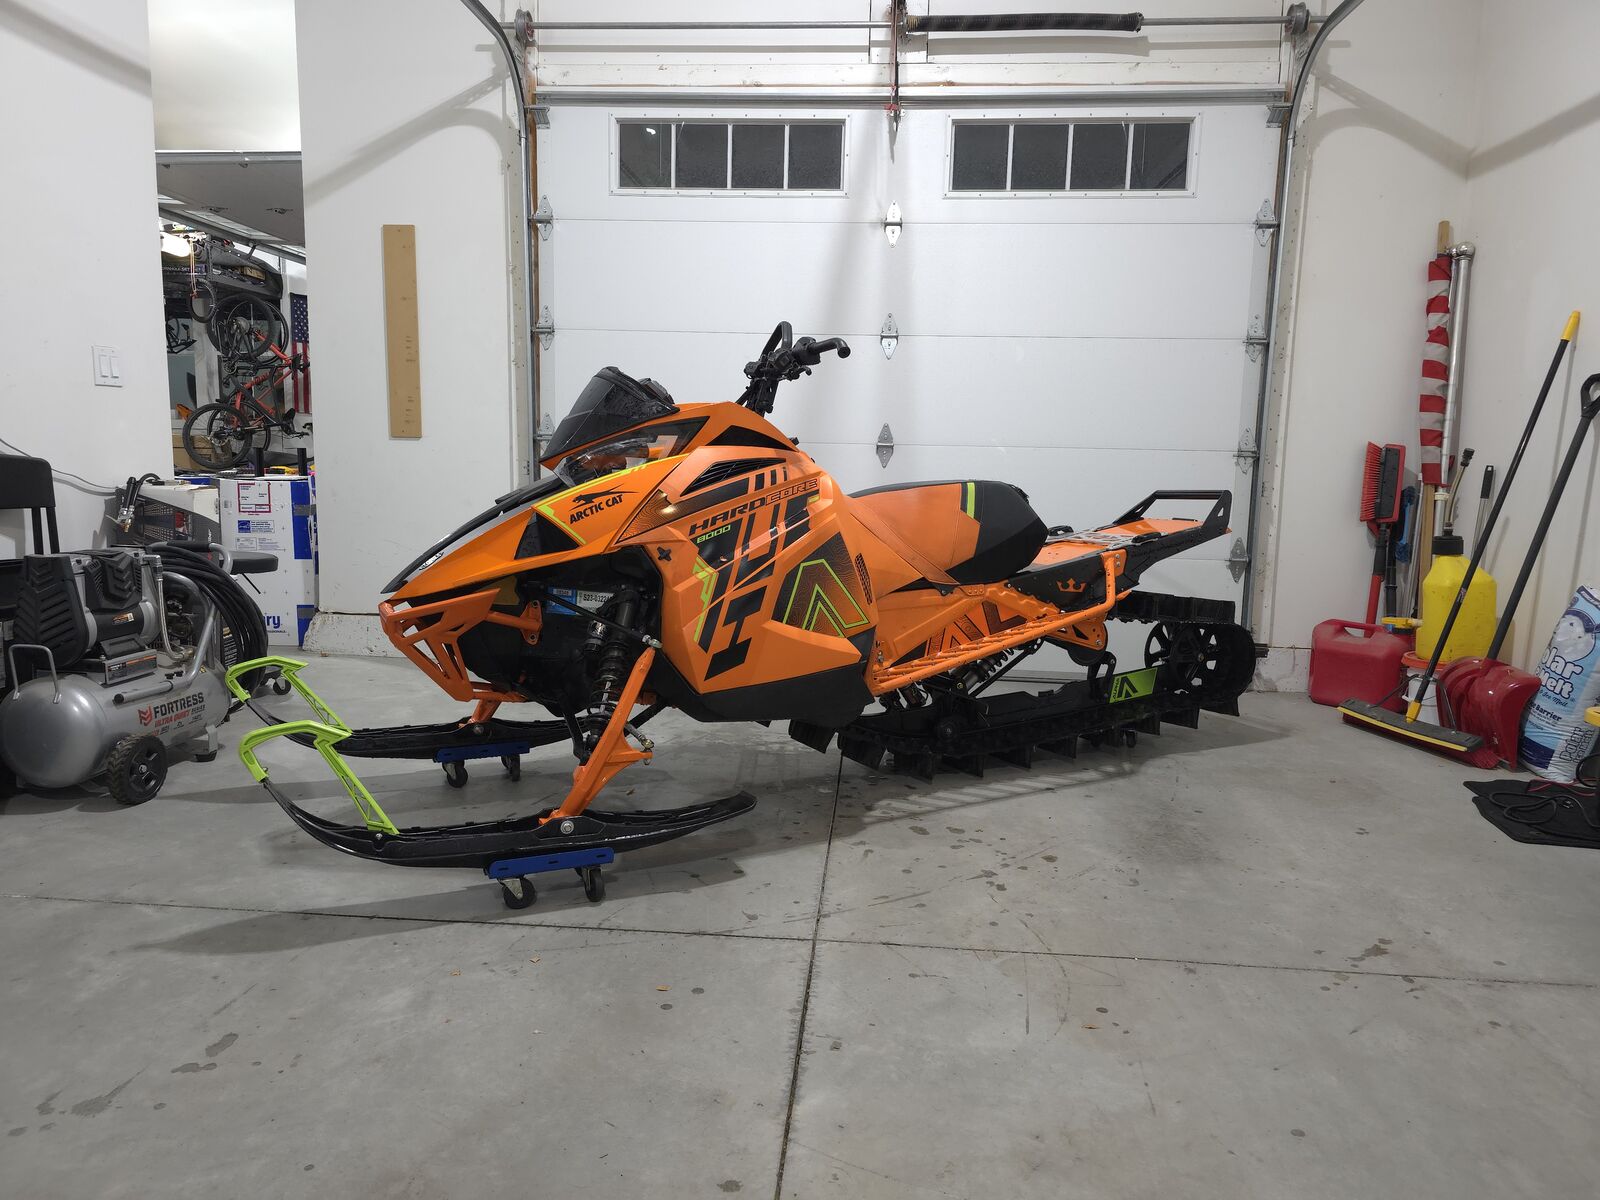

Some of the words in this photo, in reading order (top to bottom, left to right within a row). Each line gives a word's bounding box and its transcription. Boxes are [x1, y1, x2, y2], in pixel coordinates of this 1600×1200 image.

[570, 501, 605, 525] ARCTIC
[605, 494, 623, 508] CAT
[689, 479, 818, 536] HARDCORE
[697, 524, 731, 544] 8000
[1541, 646, 1584, 680] olar
[153, 692, 205, 719] FORTRESS
[1535, 704, 1563, 721] Barrier
